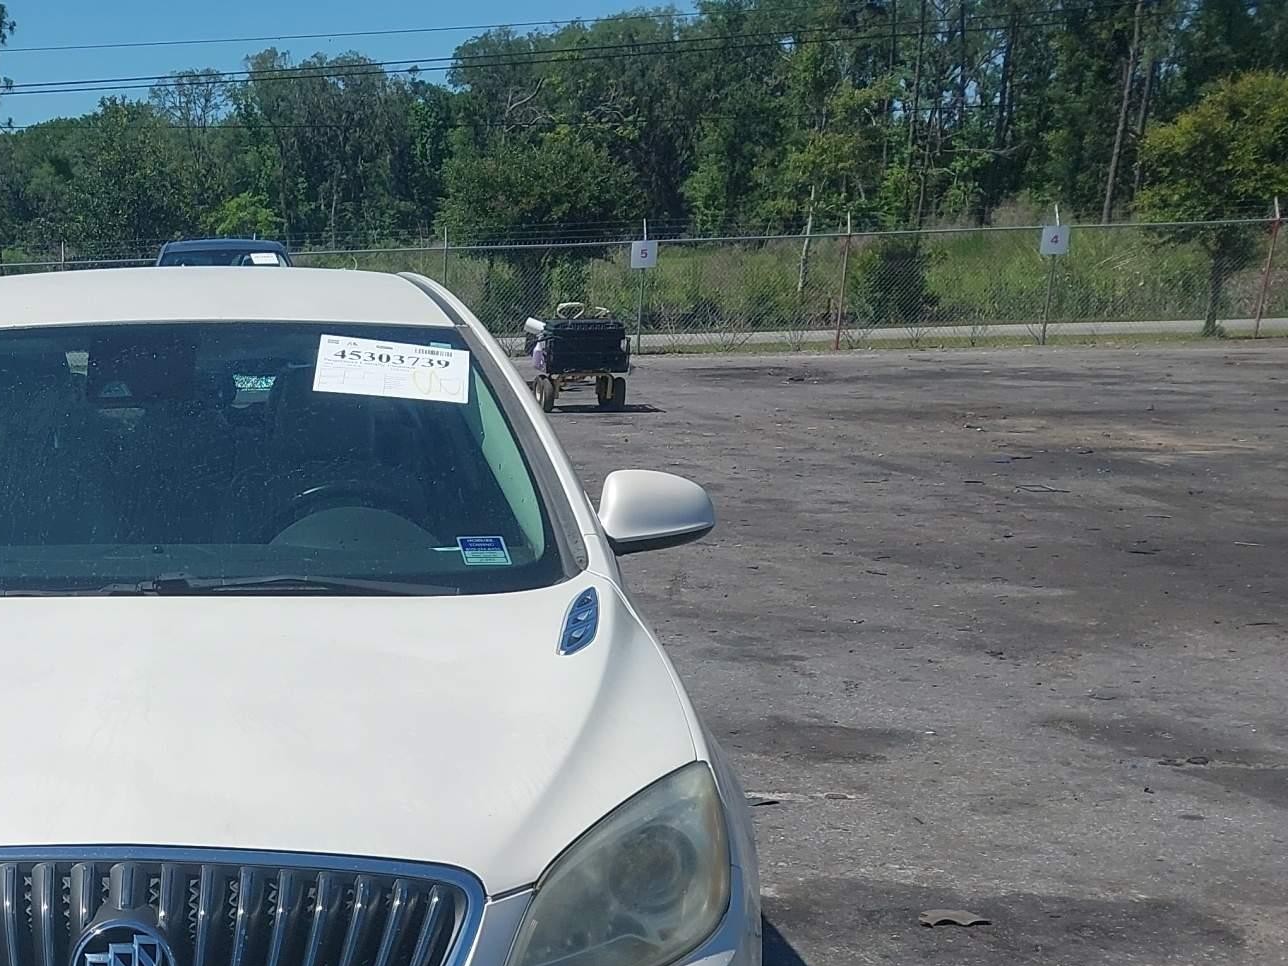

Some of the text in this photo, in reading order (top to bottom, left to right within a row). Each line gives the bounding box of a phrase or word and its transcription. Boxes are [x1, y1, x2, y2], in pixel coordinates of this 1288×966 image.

[1050, 234, 1059, 244] 4
[640, 249, 648, 258] 5
[333, 349, 450, 369] 45303739
